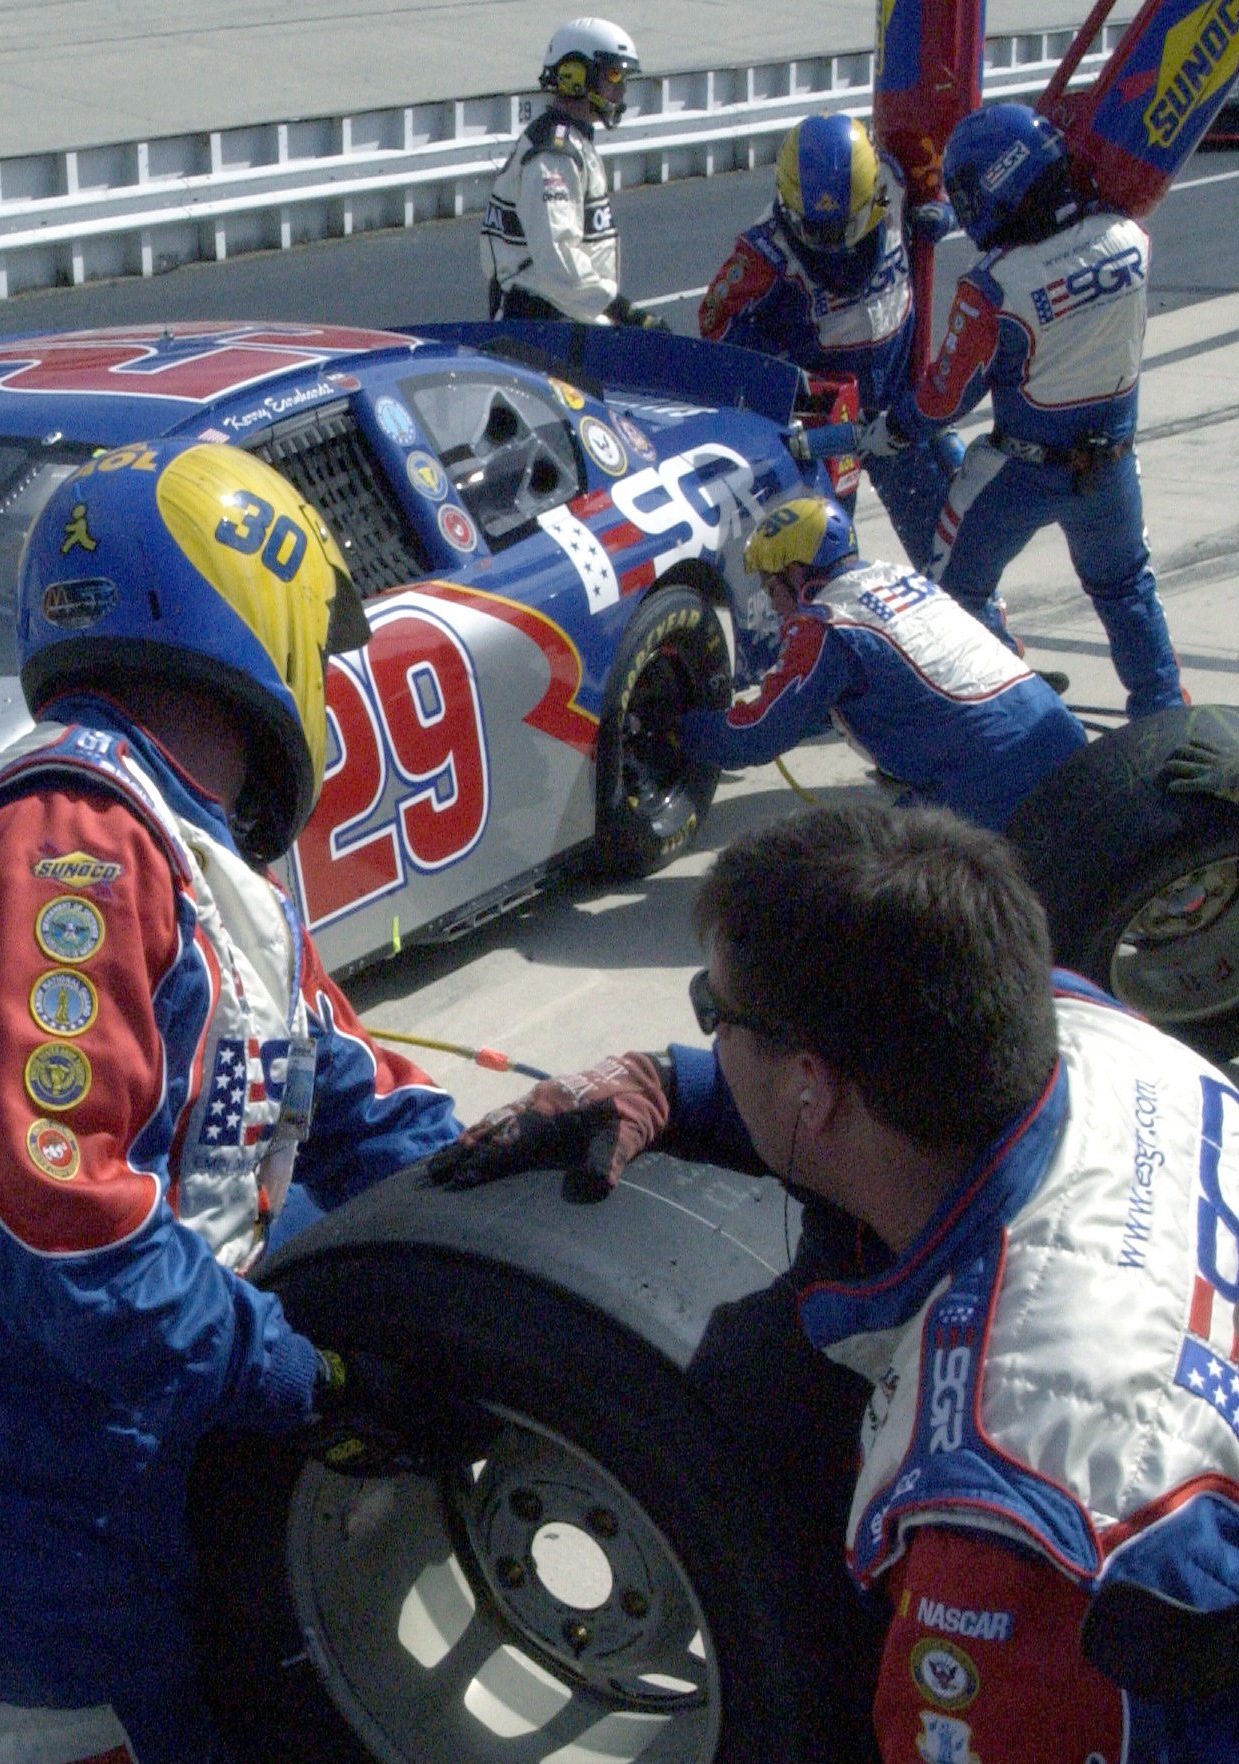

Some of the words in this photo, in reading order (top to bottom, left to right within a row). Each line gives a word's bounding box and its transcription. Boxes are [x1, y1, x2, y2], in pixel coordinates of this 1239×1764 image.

[214, 490, 307, 583] 30
[763, 508, 799, 539] 30
[295, 610, 489, 930] 29
[39, 862, 118, 880] SUNOCO
[1117, 1078, 1165, 1269] www.esgr.com
[917, 1597, 1010, 1642] NASCAR
